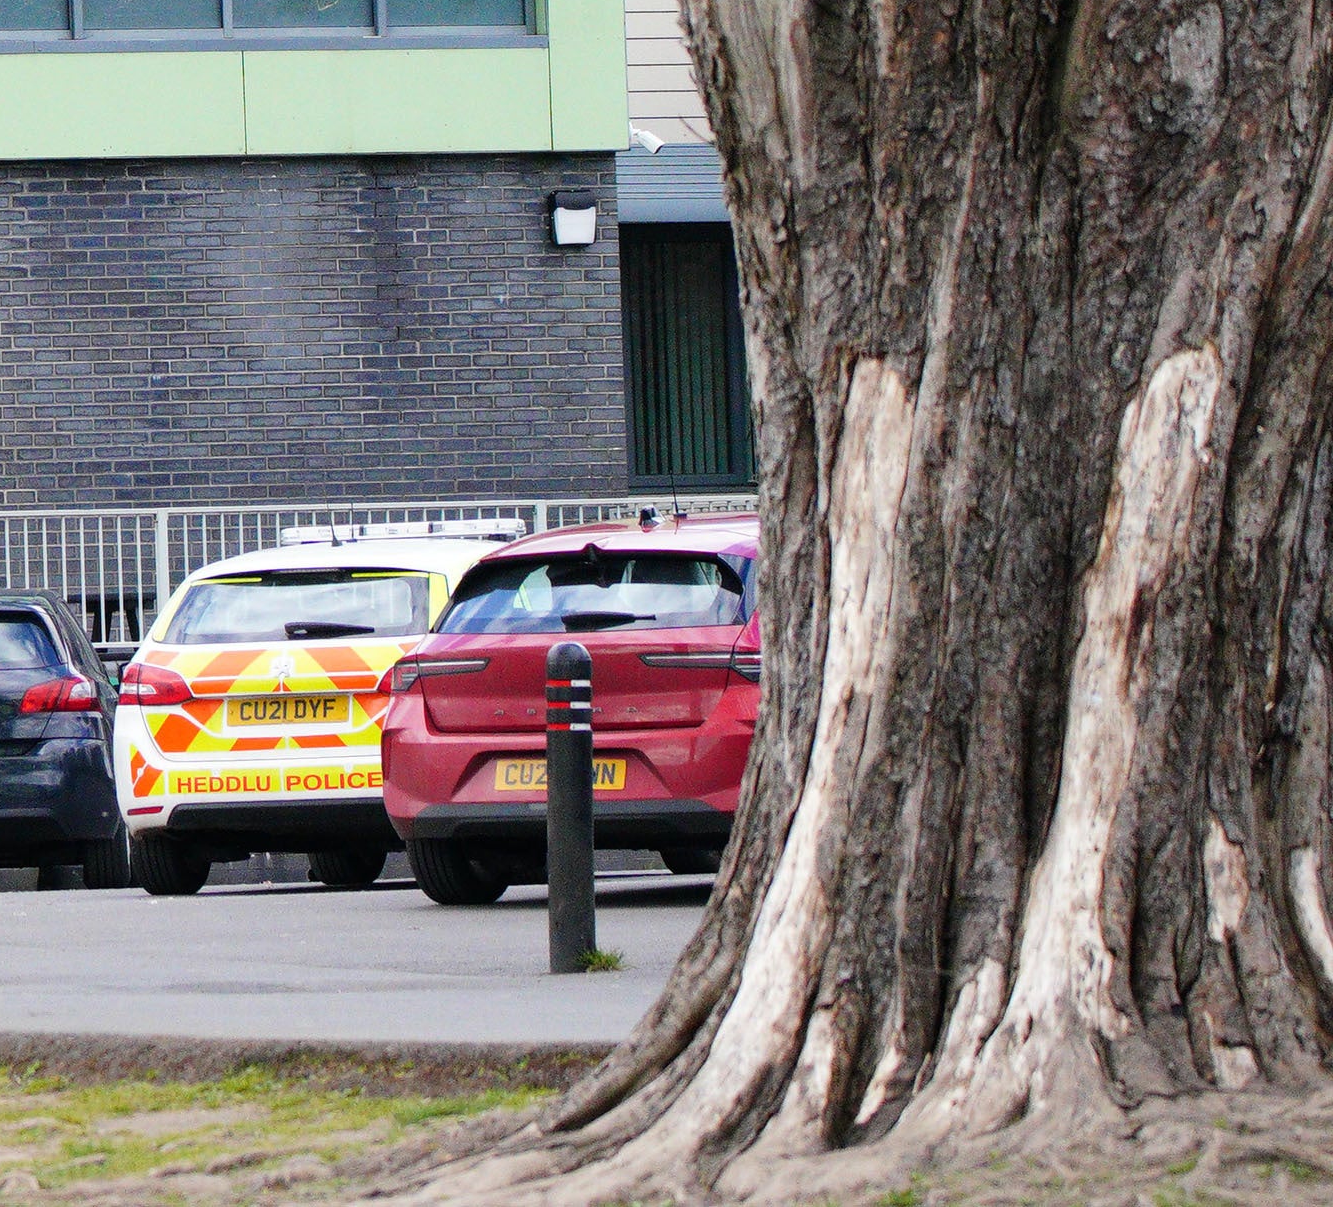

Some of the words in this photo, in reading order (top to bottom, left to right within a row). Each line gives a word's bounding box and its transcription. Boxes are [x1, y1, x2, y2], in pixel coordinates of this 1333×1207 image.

[240, 700, 287, 721] CU21
[294, 699, 336, 718] DYF
[177, 775, 271, 793] HEDDLU
[286, 771, 383, 791] POLICE
